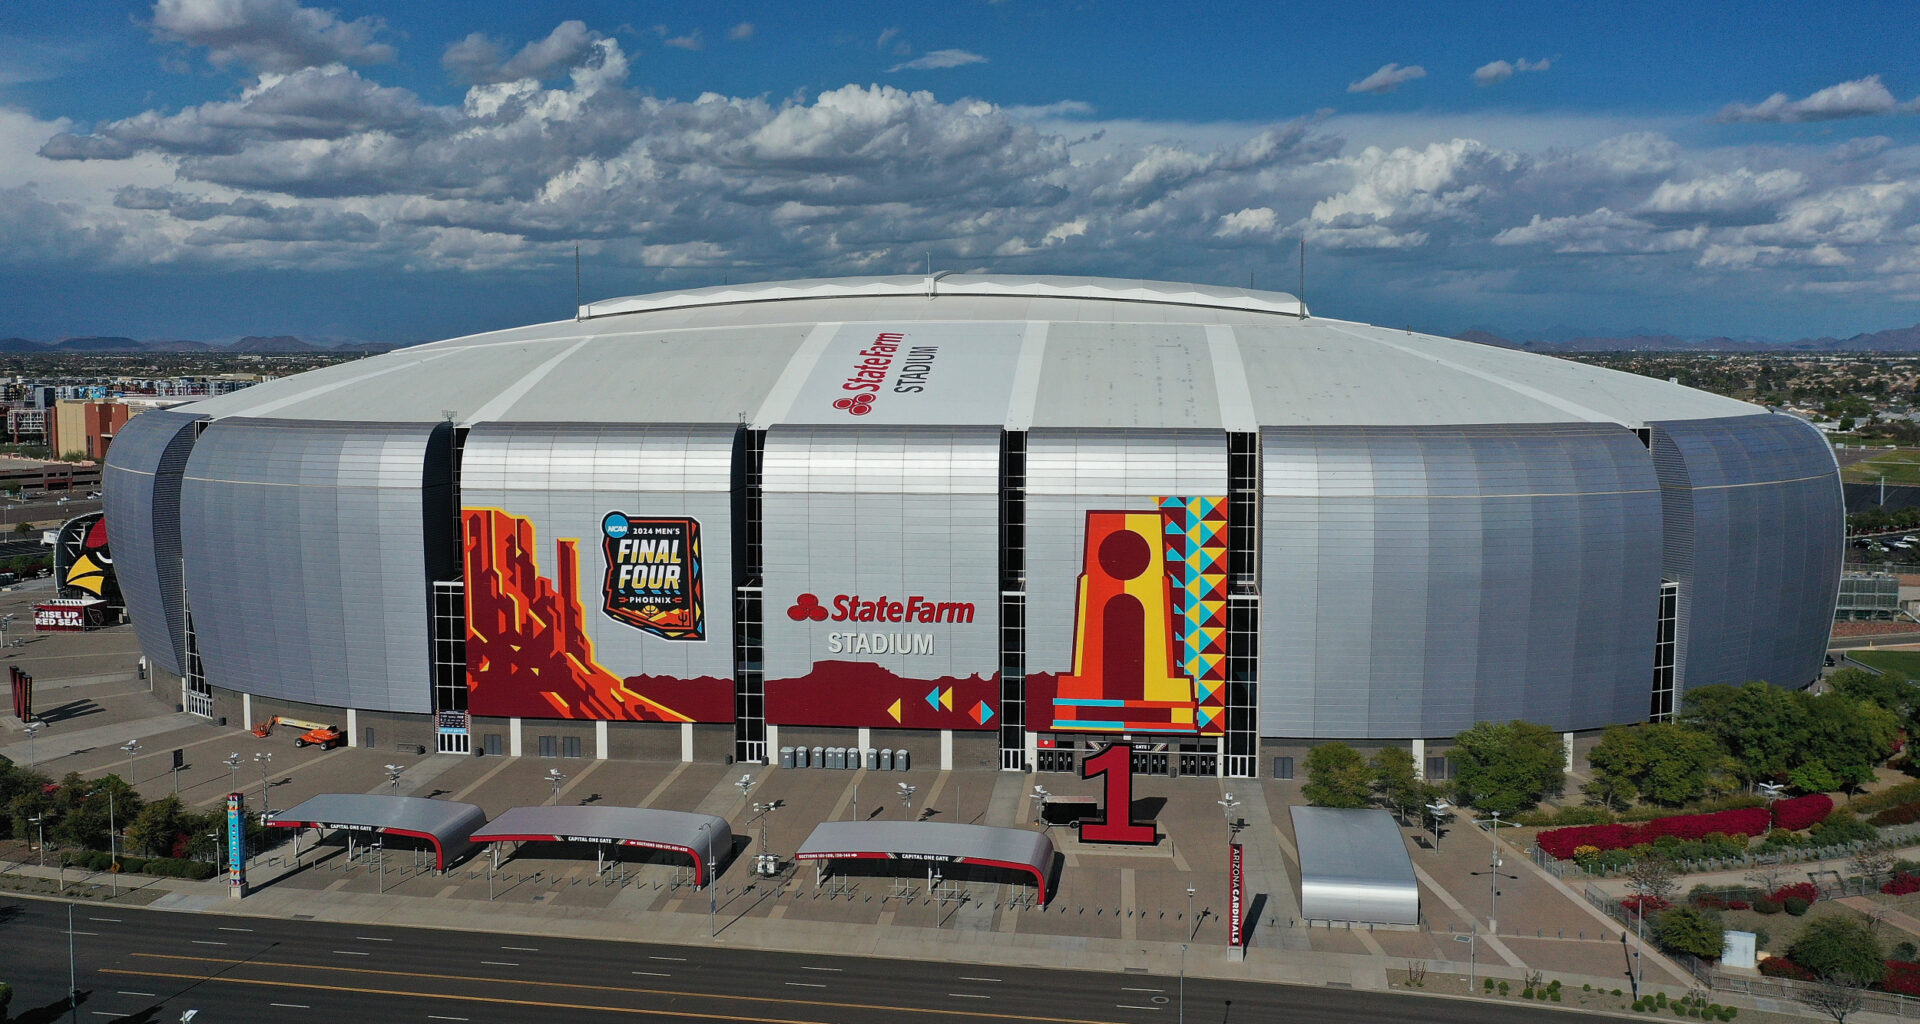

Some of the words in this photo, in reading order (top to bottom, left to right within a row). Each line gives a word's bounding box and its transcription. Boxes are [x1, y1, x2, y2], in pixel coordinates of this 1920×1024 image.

[893, 346, 939, 393] STADIUM
[607, 525, 628, 533] NCAA
[632, 527, 653, 535] 2024
[654, 527, 680, 535] MEN'S
[617, 539, 681, 564] FINAL
[618, 565, 680, 589] FOUR
[629, 596, 672, 604] PHOENIX
[35, 618, 57, 626] RED
[57, 618, 83, 627] SEA!
[38, 610, 62, 619] RISE
[63, 611, 79, 619] UP
[828, 631, 935, 656] STADIUM
[1079, 742, 1158, 846] 1
[1232, 848, 1240, 888] ARIZONA
[1231, 888, 1240, 944] CARDINALS
